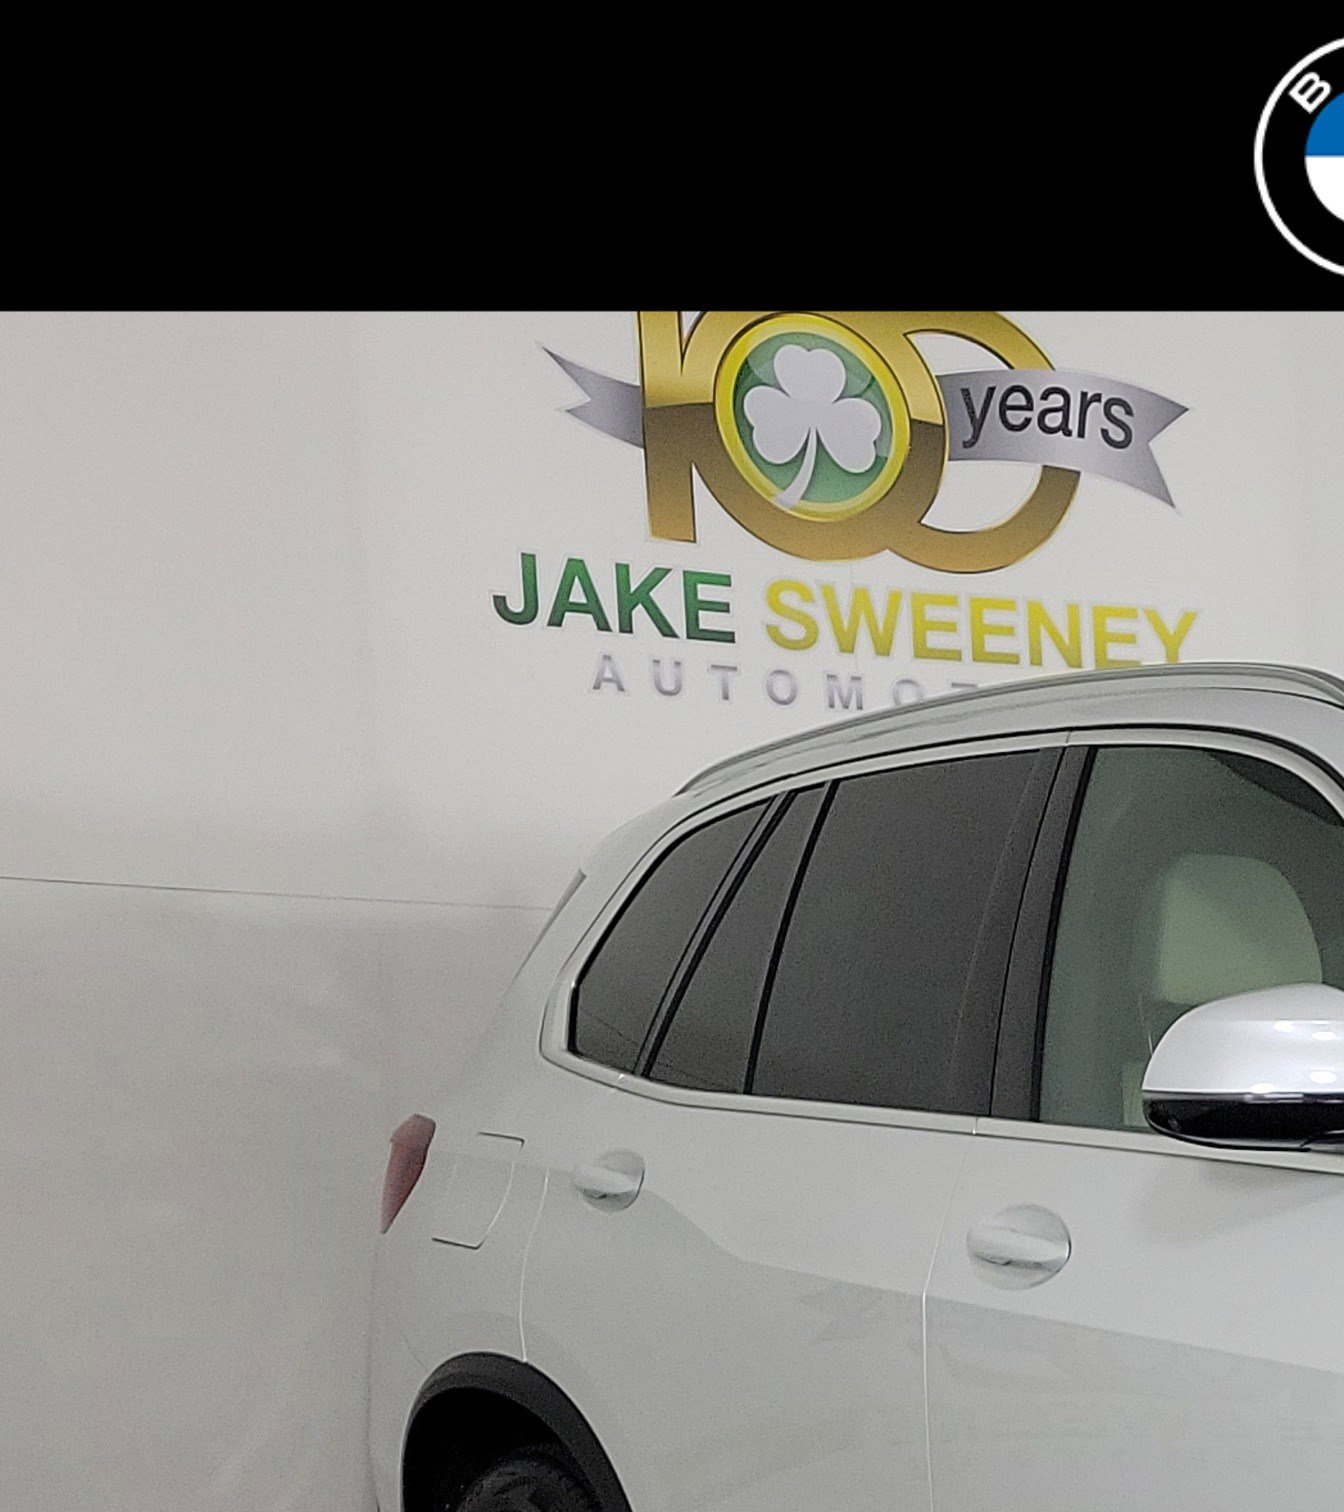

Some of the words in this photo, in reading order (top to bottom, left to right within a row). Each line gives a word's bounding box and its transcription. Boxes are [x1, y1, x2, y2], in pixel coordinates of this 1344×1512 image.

[960, 384, 1134, 450] years
[492, 552, 736, 644] JAKE
[766, 579, 1198, 669] SWEENEY
[592, 654, 981, 711] AUTOMO
